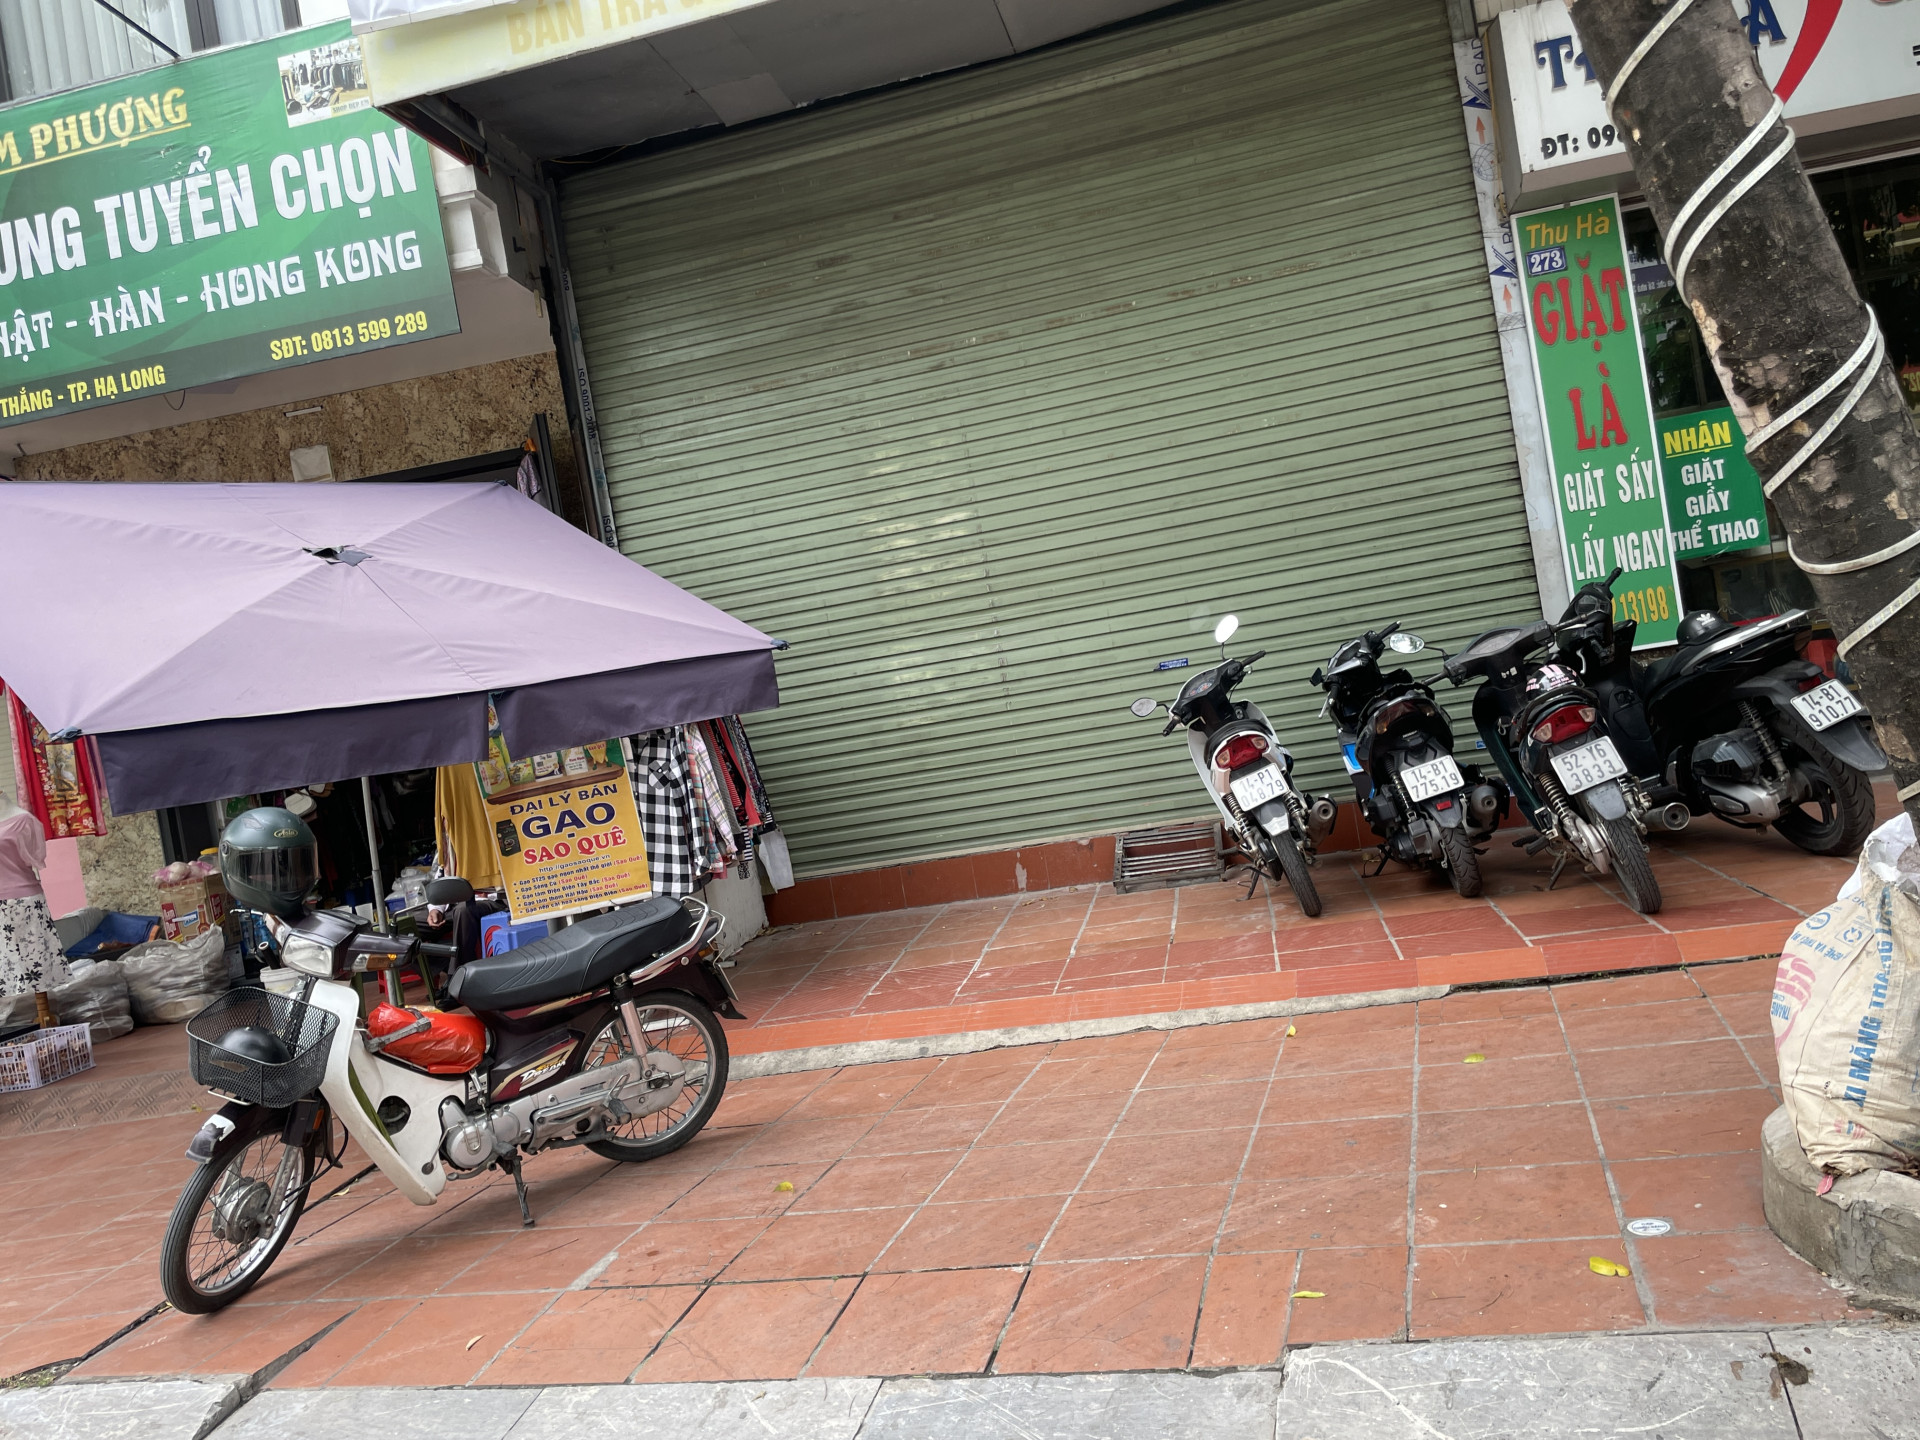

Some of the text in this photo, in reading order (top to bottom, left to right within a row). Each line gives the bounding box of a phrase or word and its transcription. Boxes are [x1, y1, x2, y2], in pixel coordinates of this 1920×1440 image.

[29, 87, 188, 160] PHƯỢNG
[1540, 124, 1622, 159] ĐT: 09
[94, 145, 259, 260] TUYỂN
[270, 127, 417, 220] CHỌN
[1525, 208, 1610, 249] Thu Hà
[1530, 250, 1563, 273] 273
[89, 285, 166, 337] HÀN
[200, 257, 306, 313] HONG
[314, 230, 422, 289] KONG
[1531, 252, 1627, 352] GIẶT
[270, 311, 428, 361] SĐT: 0813 599 289
[0, 387, 53, 418] THẮNG
[67, 381, 91, 404] TP.
[94, 375, 118, 400] HẠ
[121, 365, 166, 393] LONG
[1568, 361, 1629, 451] LÀ
[1663, 420, 1732, 455] NHẬN
[1563, 446, 1655, 517] GIẶT SẤY
[1681, 457, 1724, 486] GIẶT
[1685, 485, 1729, 517] GIẦY
[1570, 524, 1666, 581] LẤY NGAY
[1670, 518, 1759, 552] THỂ THAO
[1801, 682, 1842, 711] 14-B1
[1808, 696, 1859, 728] 910.77
[1411, 759, 1449, 783] 14-B1
[1560, 743, 1607, 772] 52-Y6
[1570, 759, 1617, 788] 3833
[1240, 769, 1273, 793] 14-P1
[1411, 773, 1460, 800] 775.19
[509, 783, 618, 816] ĐẠI LÝ BÁN
[521, 802, 616, 839] GẠO
[523, 826, 627, 866] SAO QUÊ
[1848, 1015, 1883, 1082] MĂNG
[1842, 1085, 1868, 1109] XI
